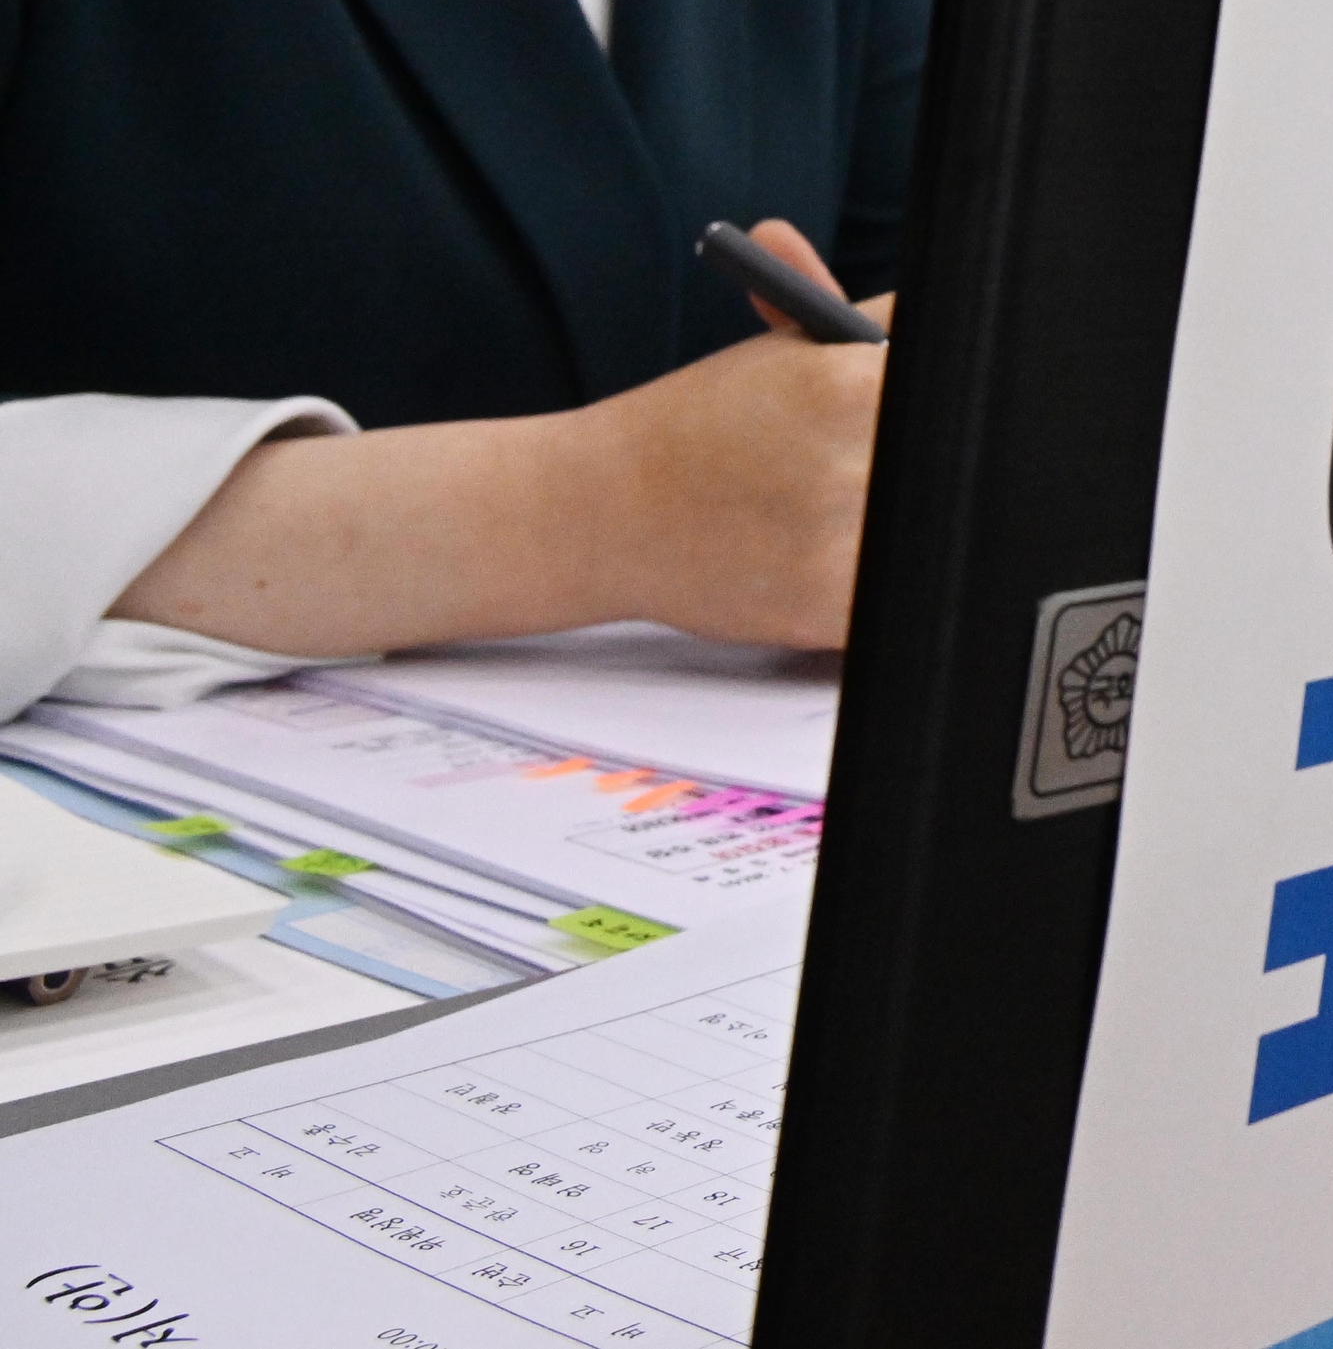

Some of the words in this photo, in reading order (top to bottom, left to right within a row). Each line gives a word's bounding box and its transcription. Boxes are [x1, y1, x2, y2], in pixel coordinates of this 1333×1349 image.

[302, 1122, 381, 1158] 김수흥
[646, 1118, 724, 1153] 정동만
[508, 1161, 592, 1199] 엄태영
[439, 1184, 519, 1222] 한준호
[703, 1190, 741, 1207] 18
[349, 1207, 446, 1252] 위원성명
[632, 1215, 674, 1231] 17
[560, 1239, 602, 1257] 16
[471, 1261, 532, 1288] 순번
